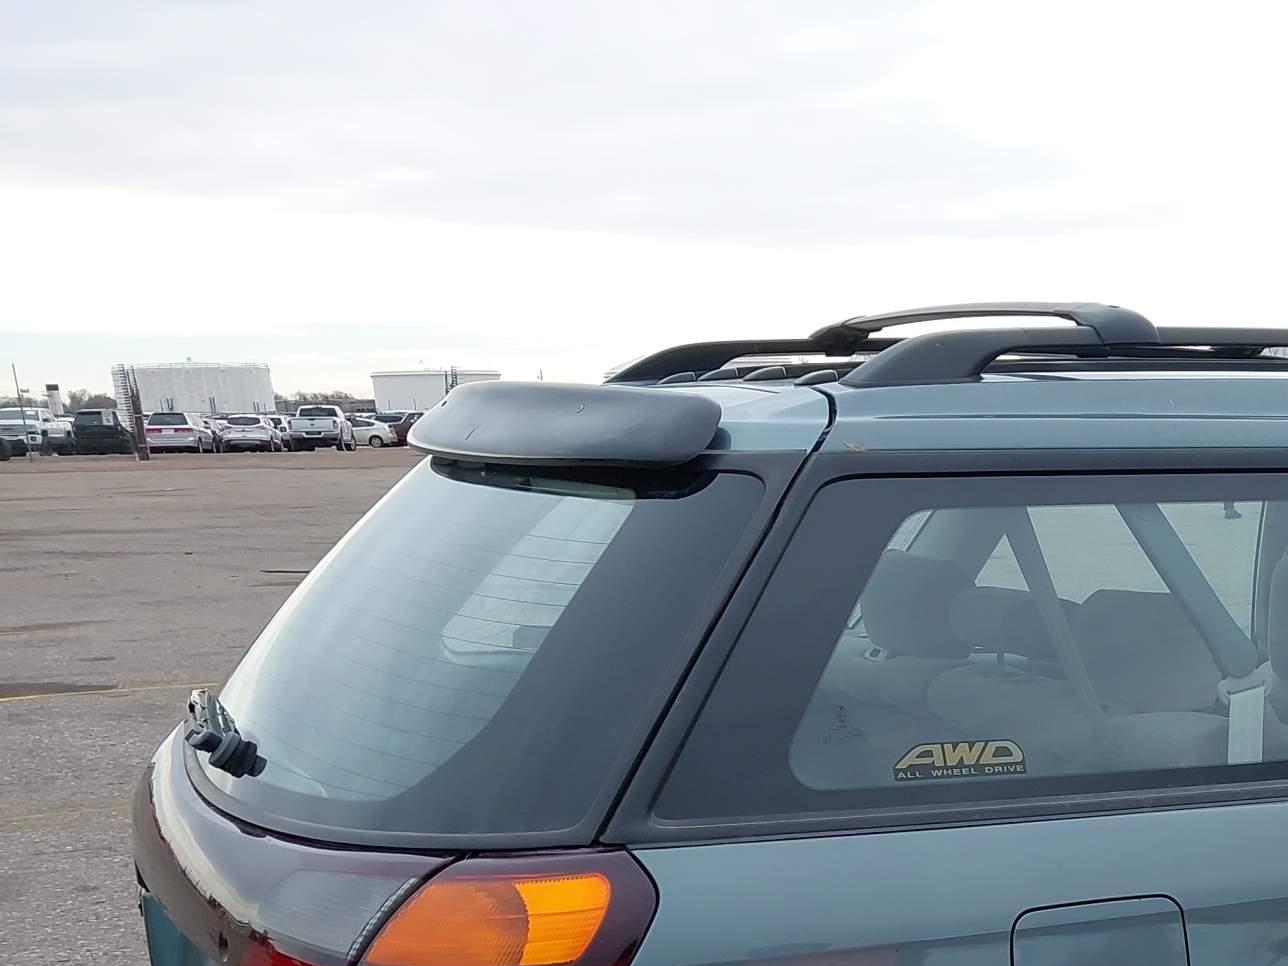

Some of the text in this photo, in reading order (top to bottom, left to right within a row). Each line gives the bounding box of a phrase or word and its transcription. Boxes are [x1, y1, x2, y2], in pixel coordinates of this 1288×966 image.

[895, 740, 1024, 769] AWD
[897, 764, 1025, 780] ALL WHEEL DRIVE
